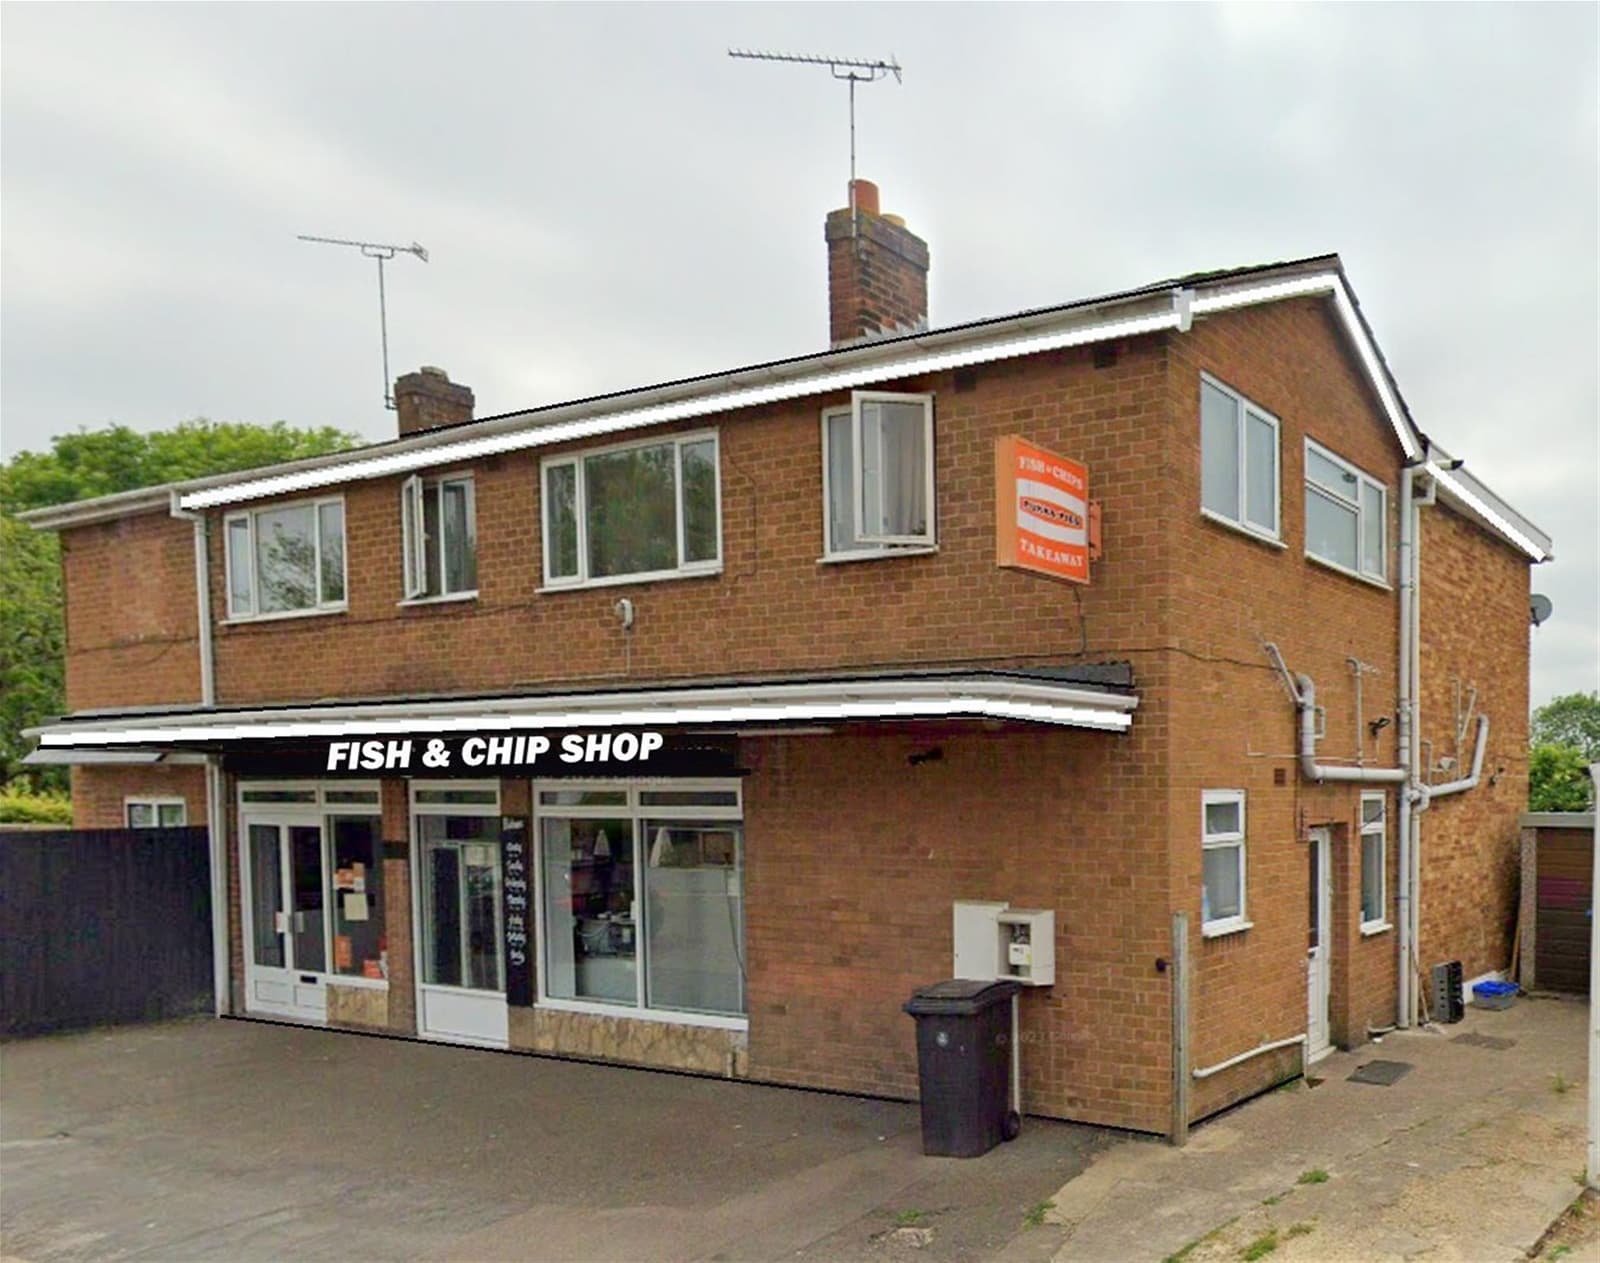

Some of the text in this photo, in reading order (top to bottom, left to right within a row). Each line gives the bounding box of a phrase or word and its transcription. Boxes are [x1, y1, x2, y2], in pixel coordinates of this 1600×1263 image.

[1018, 455, 1045, 474] FISH
[1052, 465, 1083, 490] CHIPS
[1019, 537, 1083, 567] TAKEAWAY
[327, 732, 664, 771] FISH & CHIP SHOP
